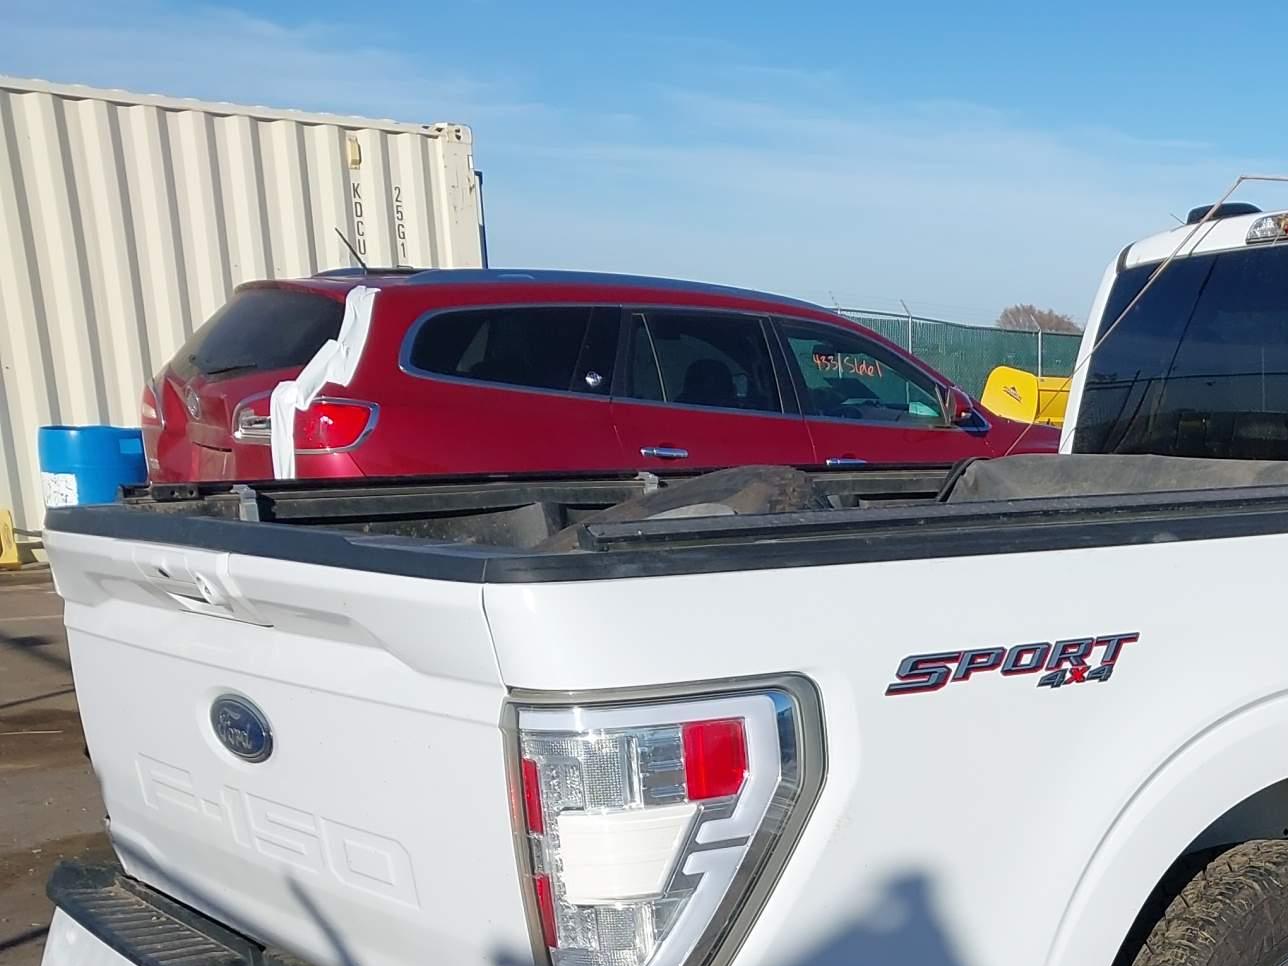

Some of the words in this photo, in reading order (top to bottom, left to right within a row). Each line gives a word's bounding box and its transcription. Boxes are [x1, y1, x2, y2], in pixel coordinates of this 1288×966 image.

[352, 183, 366, 255] KDCU
[394, 186, 406, 258] 25G1
[885, 632, 1140, 696] SPORT
[217, 705, 253, 750] Ford
[136, 752, 420, 912] F-150
